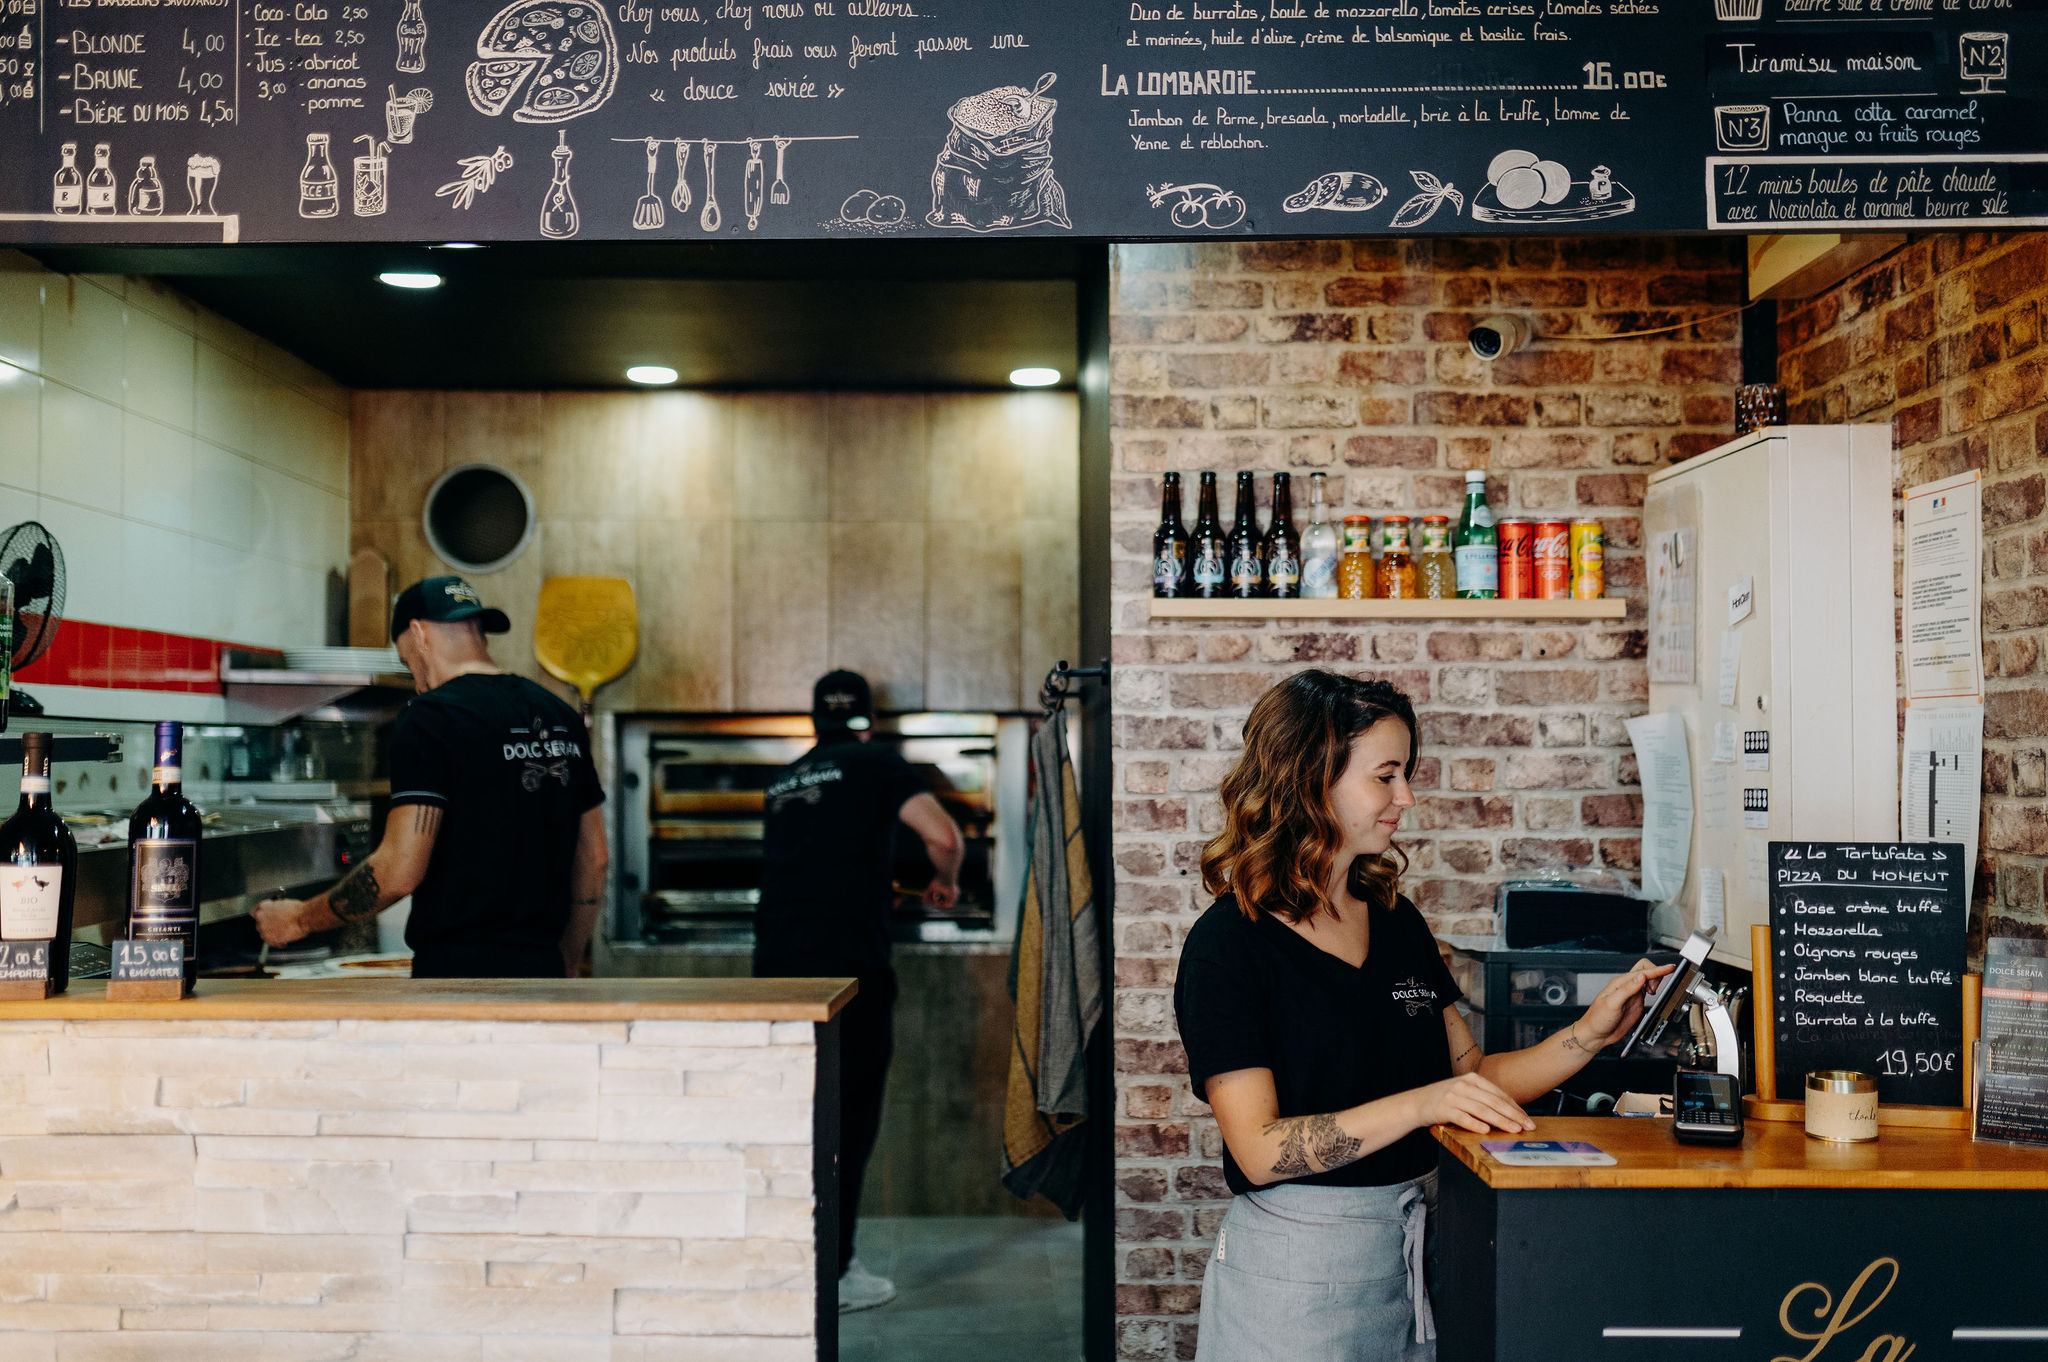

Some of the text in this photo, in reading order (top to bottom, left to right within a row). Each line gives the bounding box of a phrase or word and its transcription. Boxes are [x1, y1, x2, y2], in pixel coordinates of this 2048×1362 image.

[341, 5, 369, 23] 2,50
[660, 7, 708, 26] vous,
[761, 2, 805, 19] nous
[814, 1, 836, 17] ou
[1129, 2, 1161, 21] Duo
[1166, 3, 1186, 21] de
[1192, 0, 1266, 22] burratas,
[1269, 0, 1308, 19] boule
[1313, 1, 1331, 19] de
[1335, 0, 1427, 21] mozzarella,
[1428, 0, 1482, 17] tomates
[1486, 1, 1545, 20] cerises,
[1546, 0, 1603, 15] tomates
[182, 27, 225, 58] 4,00
[335, 29, 366, 48] 2,50
[1126, 29, 1141, 47] et
[1145, 30, 1207, 51] marinées,
[1211, 27, 1245, 45] huile
[1351, 24, 1371, 43] de
[1374, 25, 1453, 48] balsamique
[1459, 26, 1475, 42] et
[1479, 25, 1526, 42] basilic
[1533, 21, 1572, 41] frais.
[626, 31, 1030, 72] Nos produits frais vous feront passer une
[1725, 43, 1922, 74] Tiramisu maison
[177, 66, 223, 96] 4,00
[257, 80, 287, 101] 3,00
[683, 76, 739, 101] douce
[764, 74, 819, 99] soirée
[133, 104, 152, 123] DU
[199, 99, 234, 128] 4,50
[307, 97, 365, 115] pomme
[1128, 96, 1631, 130] Jambon de Parme, bresaola, mortadelle, brie à la truffe, tomme de
[1783, 99, 1985, 125] Panna cotta caramel,
[1130, 131, 1269, 151] Yenne et reblochon.
[1779, 122, 1981, 153] mangue ou fruits rouges
[1723, 164, 1997, 201] 12 minis boules de pâte chaude
[1726, 205, 1758, 221] avec
[1843, 196, 1857, 219] et
[1925, 196, 1970, 218] beurre
[1980, 190, 2009, 215] salé
[1806, 844, 1827, 860] La
[1836, 846, 1927, 861] Tartufata
[1777, 868, 1822, 883] PIZZA
[1837, 868, 1858, 881] DU
[1794, 897, 1944, 915] Base crème truffe
[1793, 942, 1919, 966] Oignons rouges
[1794, 965, 1953, 985] Jambon blanc truffé
[1794, 987, 1866, 1007] Roquette
[1795, 1010, 1940, 1027] Burrata à la truffe
[1875, 1049, 1956, 1078] 19,50€
